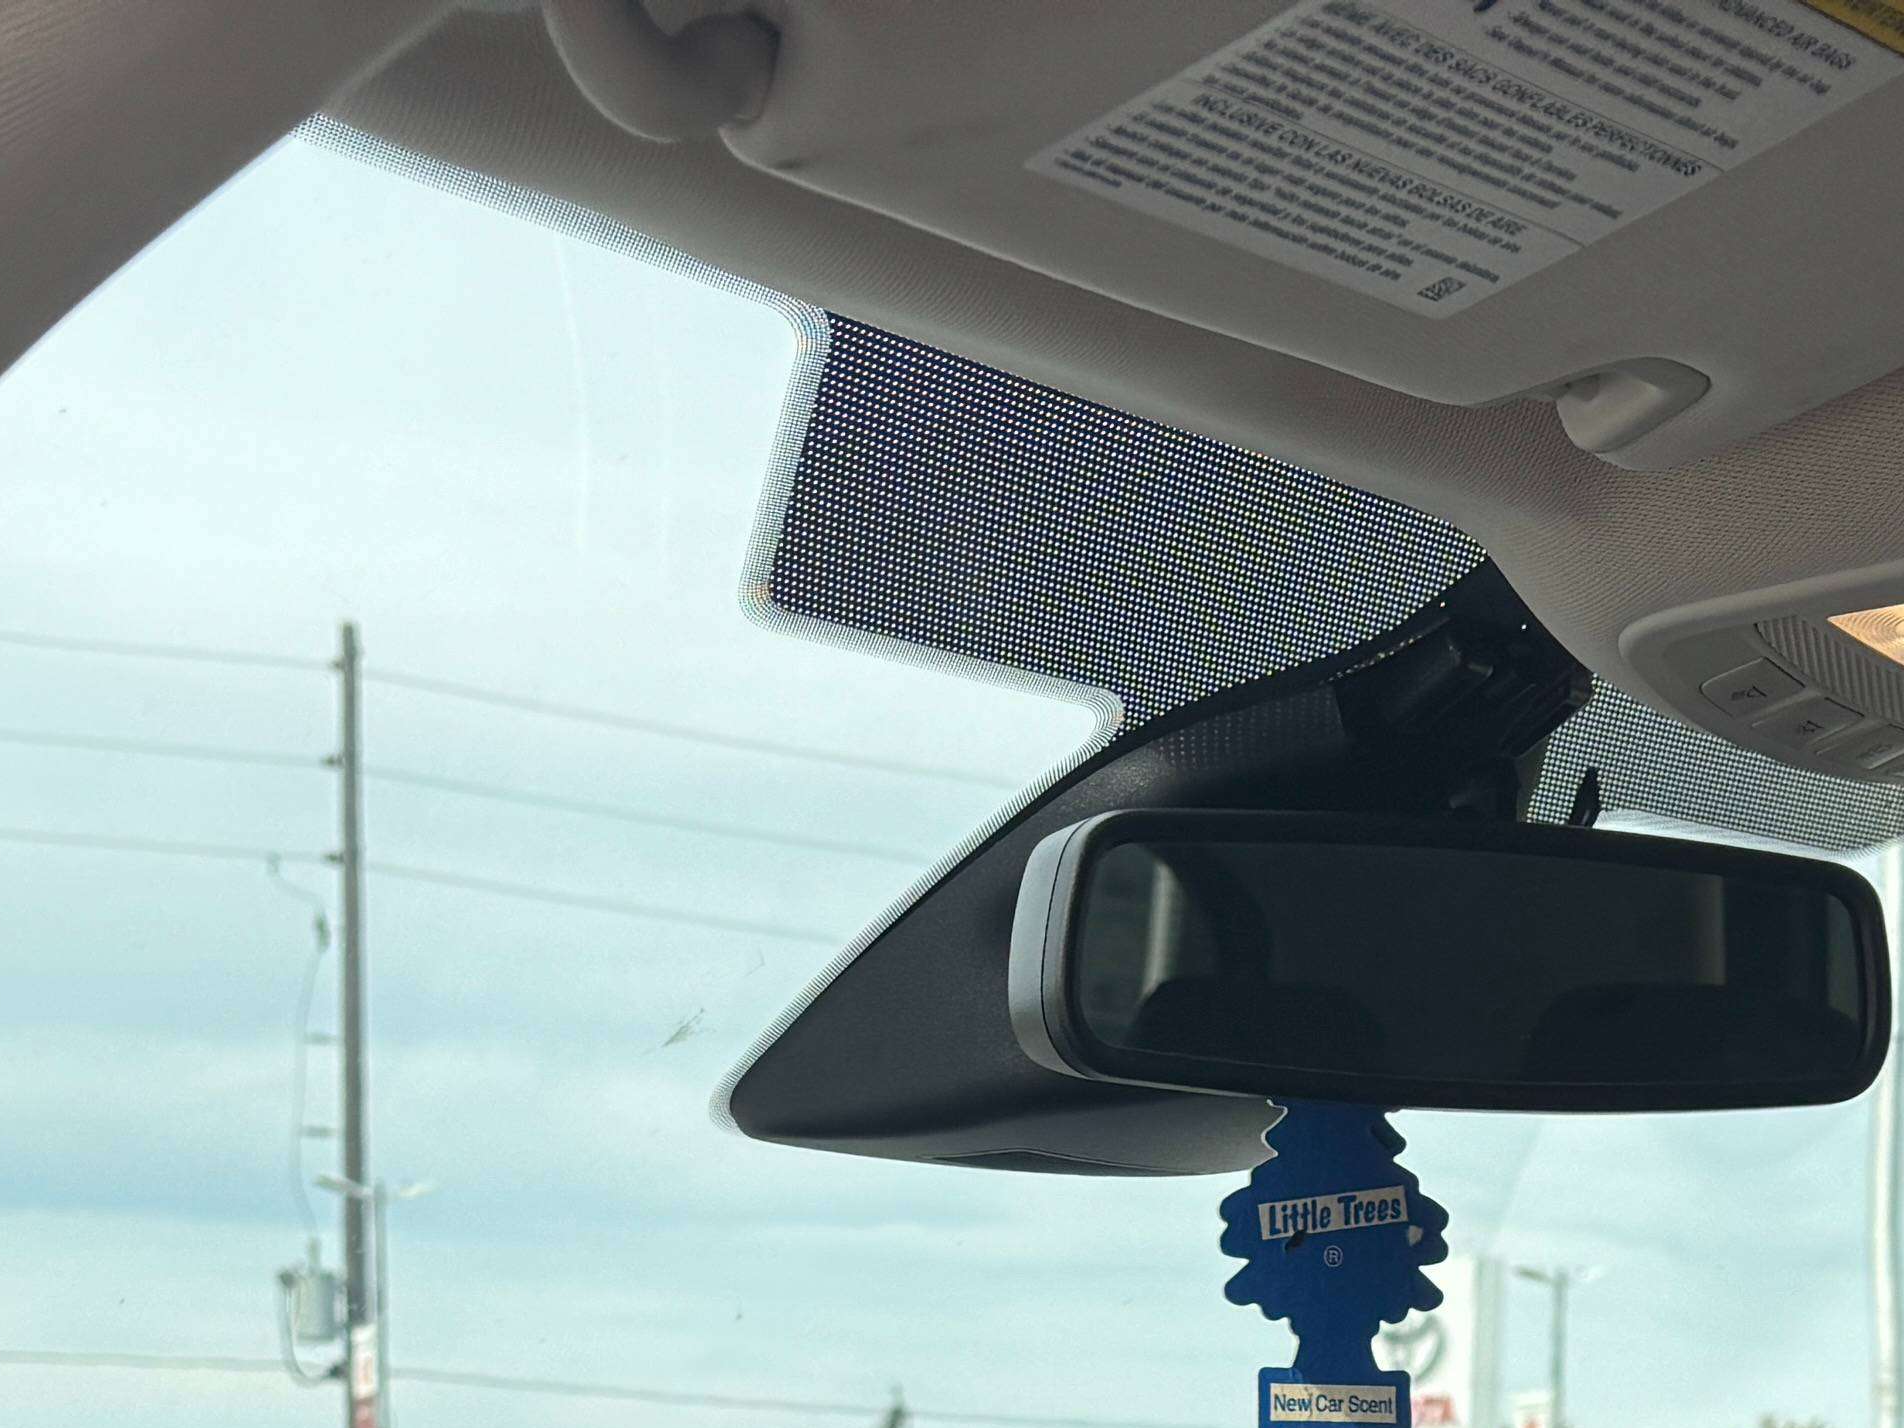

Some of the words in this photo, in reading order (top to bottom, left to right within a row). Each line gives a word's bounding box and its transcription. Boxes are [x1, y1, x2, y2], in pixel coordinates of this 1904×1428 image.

[1269, 1200, 1332, 1236] Little
[1338, 1194, 1402, 1225] Trees
[1274, 1393, 1311, 1413] New
[1315, 1395, 1345, 1412] Car
[1348, 1394, 1393, 1413] Scent
